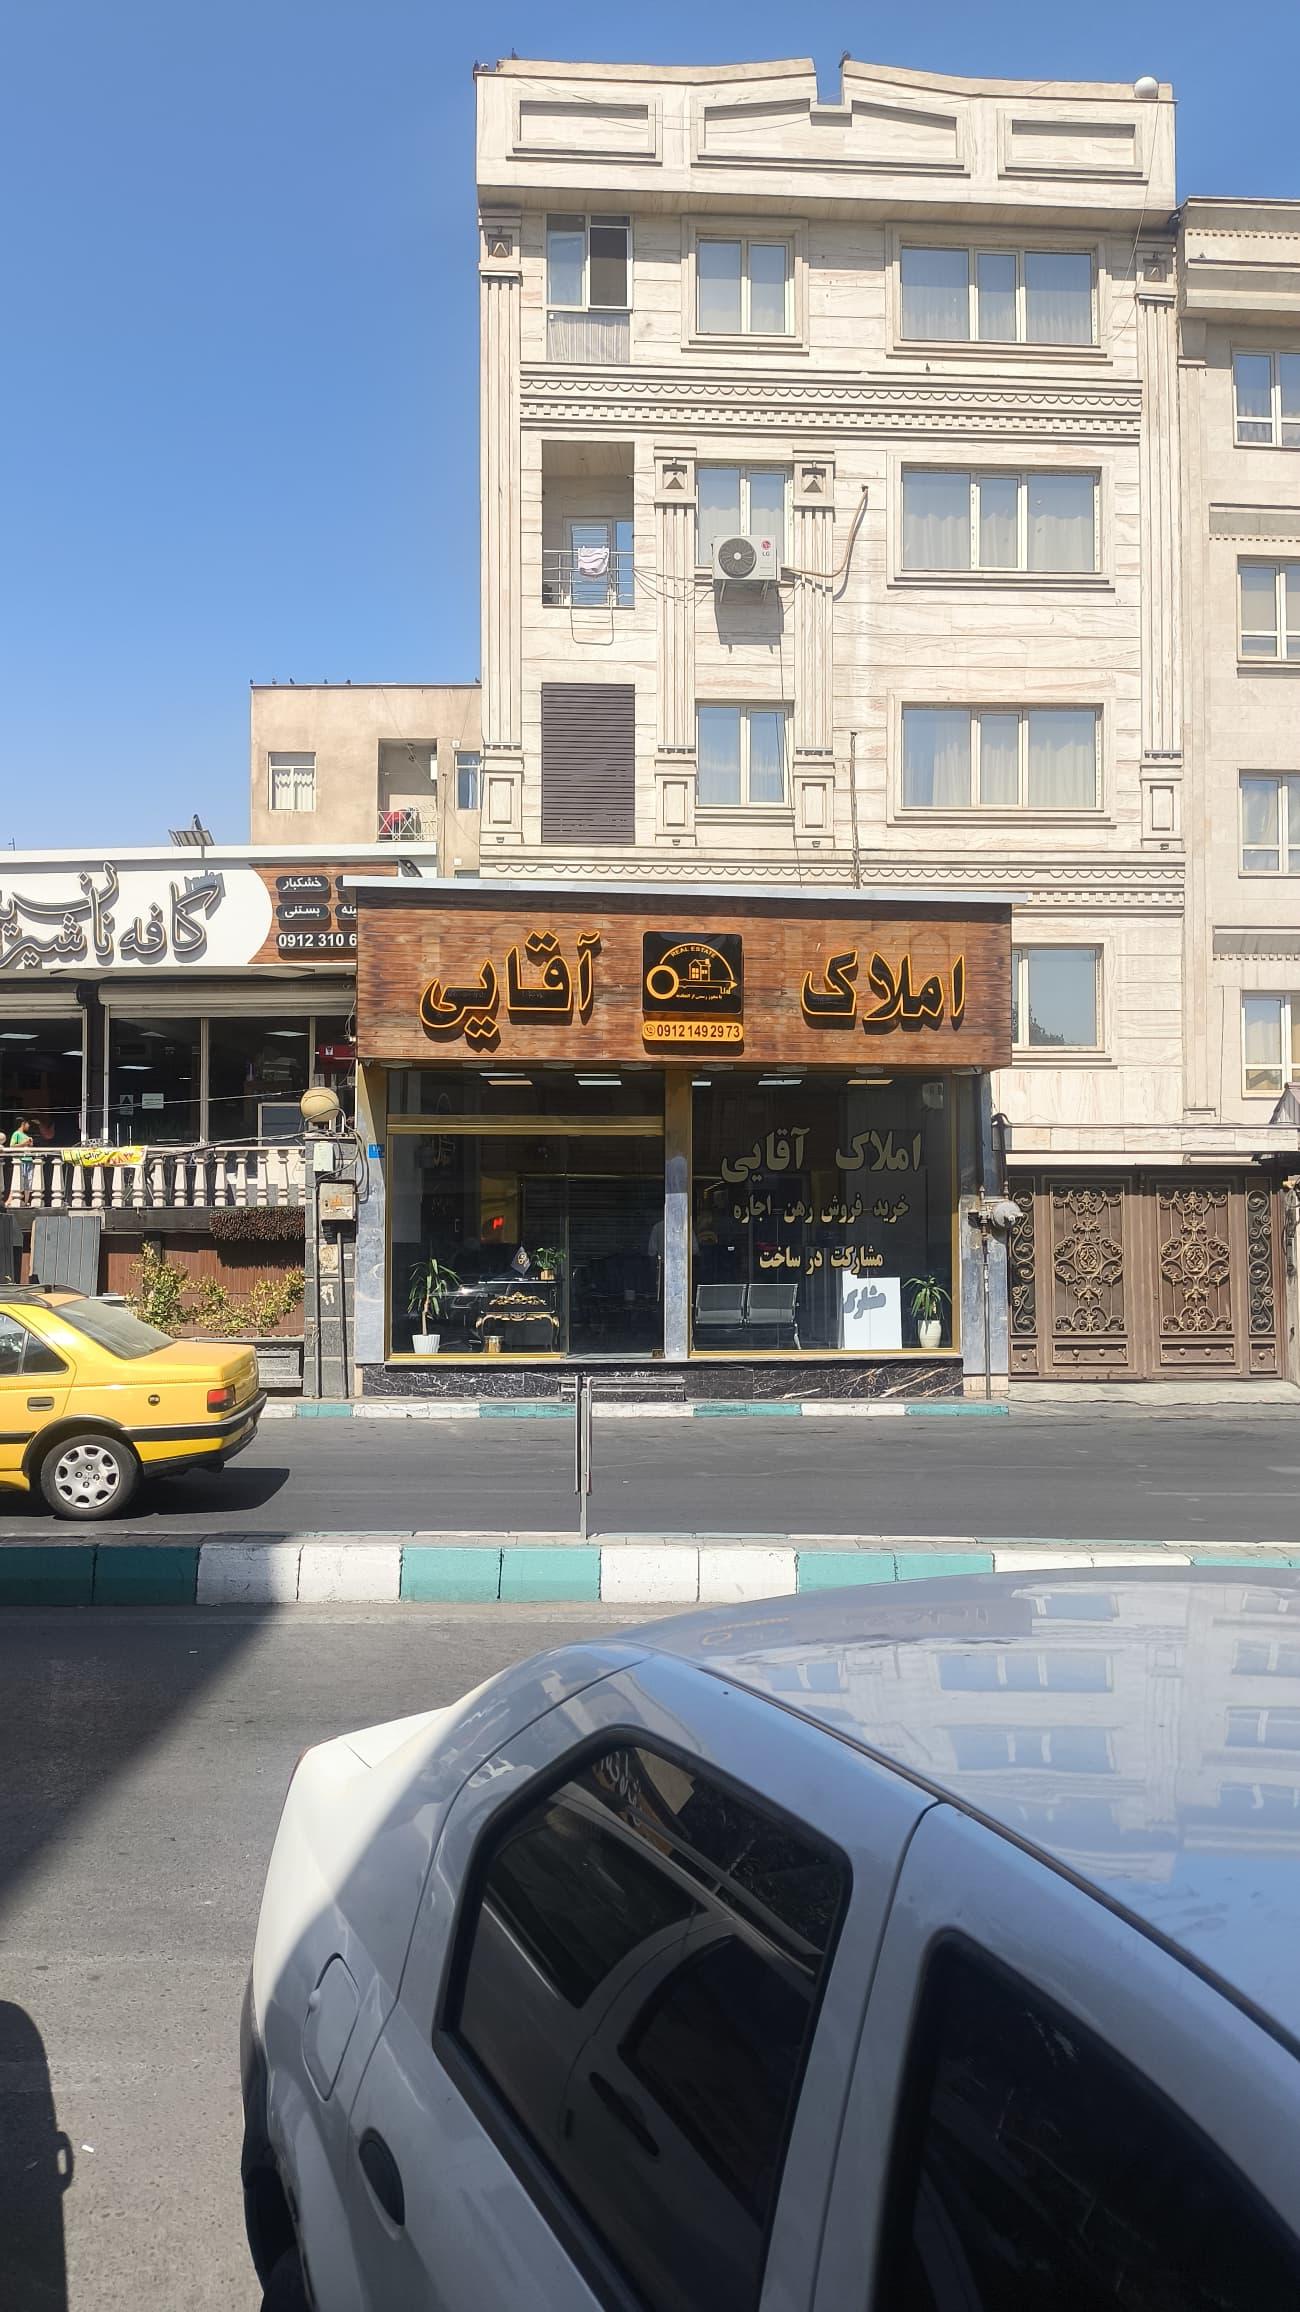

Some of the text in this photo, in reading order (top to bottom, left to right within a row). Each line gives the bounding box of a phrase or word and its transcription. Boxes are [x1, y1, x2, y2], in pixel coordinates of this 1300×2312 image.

[282, 877, 322, 891] خشکبار
[119, 881, 218, 954] کافه
[284, 905, 321, 918] بستنی
[278, 934, 314, 947] 0912
[318, 934, 344, 947] 310
[671, 946, 716, 958] REAL ESTATE
[419, 930, 965, 1038] املاک آقایی
[721, 1127, 922, 1182] املاک آقایی
[733, 1193, 910, 1223] خرید فروش رهن اجاره
[759, 1245, 884, 1275] مشارکت در ساخت
